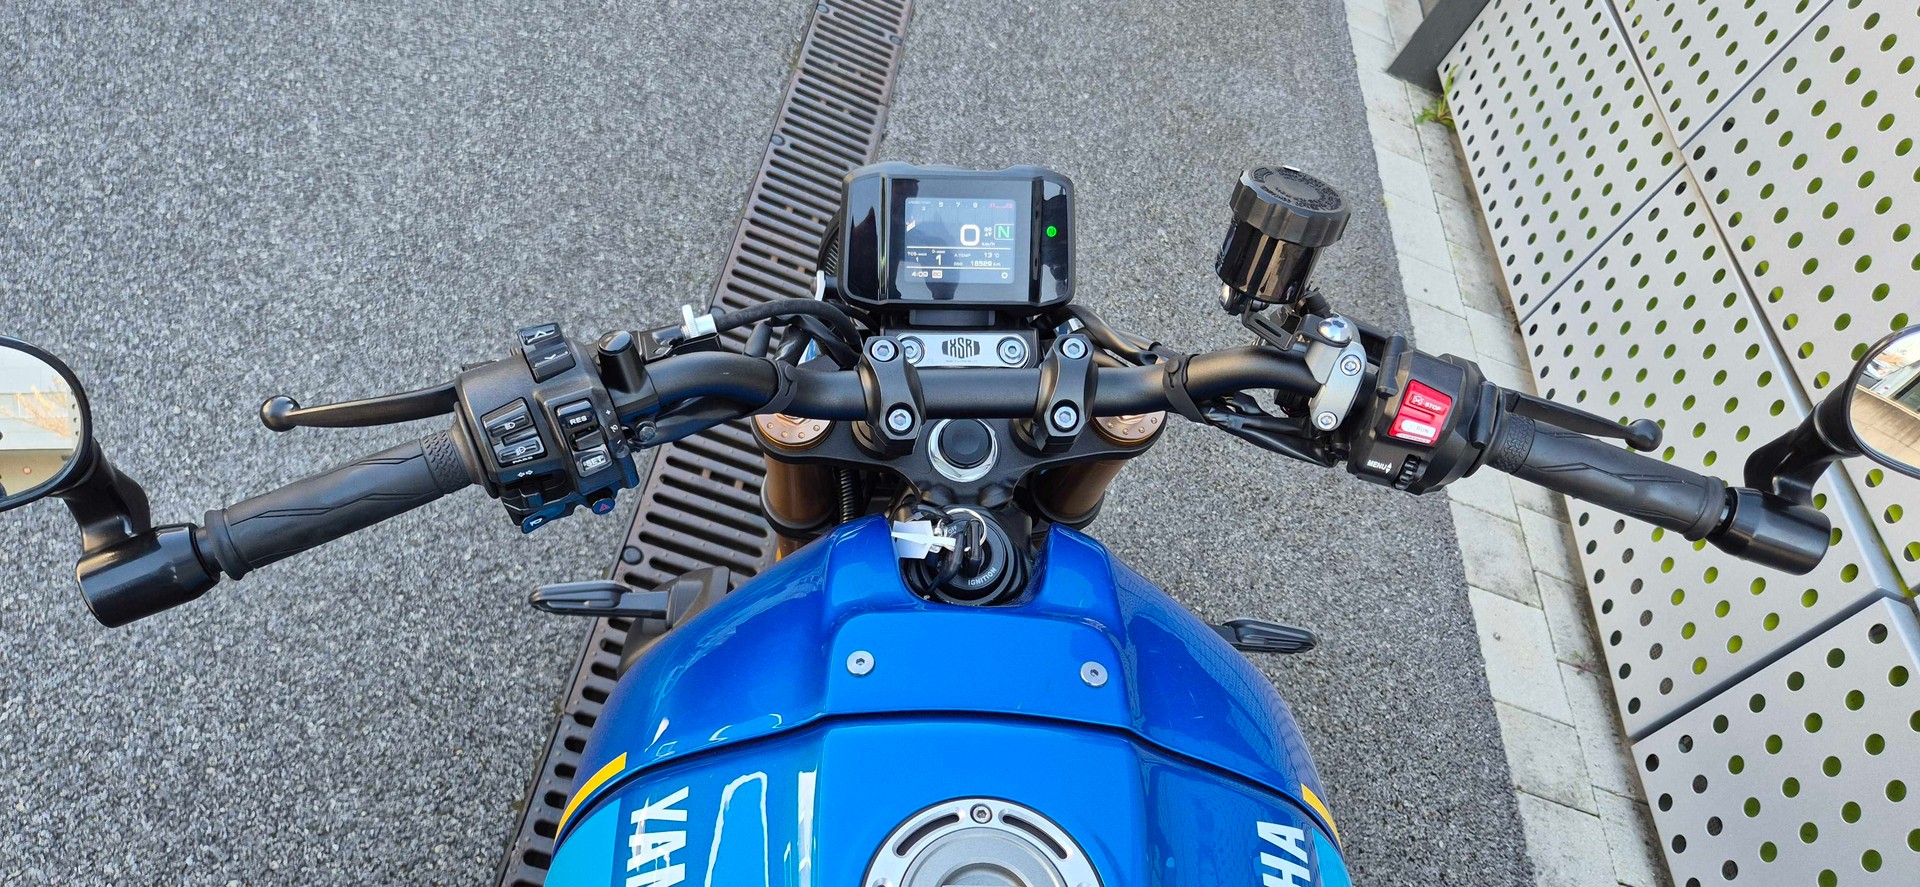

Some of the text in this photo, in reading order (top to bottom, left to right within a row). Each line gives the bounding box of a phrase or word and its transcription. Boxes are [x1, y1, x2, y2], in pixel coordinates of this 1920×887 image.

[998, 225, 1010, 239] N
[935, 254, 942, 266] 1
[950, 337, 973, 359] XSR
[1424, 401, 1441, 411] STOP
[569, 415, 588, 426] RES
[1367, 459, 1387, 470] MENU
[968, 567, 997, 586] IGNITION
